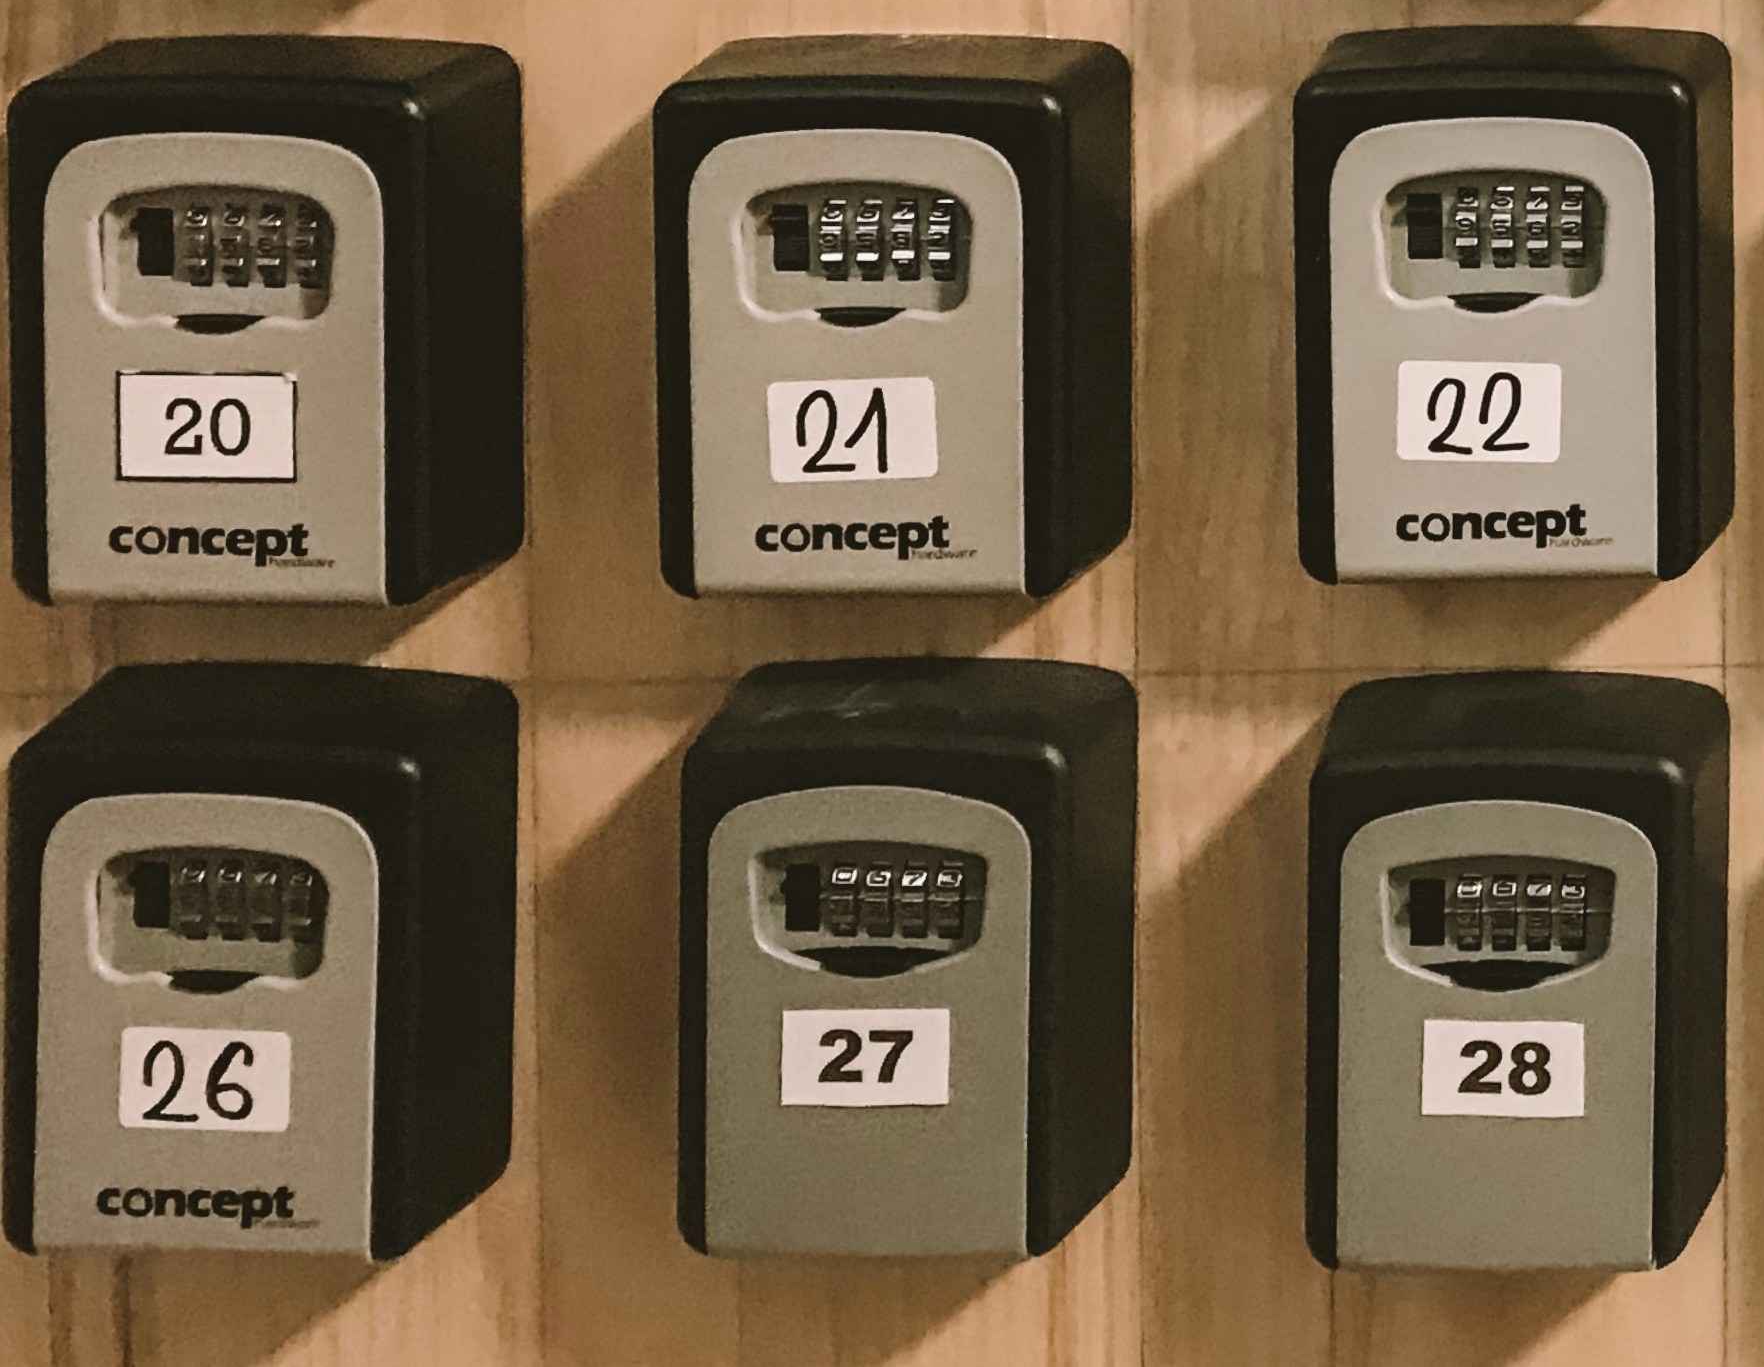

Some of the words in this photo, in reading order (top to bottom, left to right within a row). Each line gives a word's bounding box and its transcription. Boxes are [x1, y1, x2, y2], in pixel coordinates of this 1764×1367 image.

[163, 397, 251, 457] 20
[795, 387, 889, 474] 21
[1426, 371, 1530, 456] 22
[108, 523, 311, 568] concept
[754, 515, 950, 561] concept
[1395, 503, 1588, 549] concept
[142, 1040, 254, 1123] 26
[817, 1028, 914, 1084] 27
[1457, 1040, 1552, 1096] 28
[97, 1185, 295, 1230] concept
